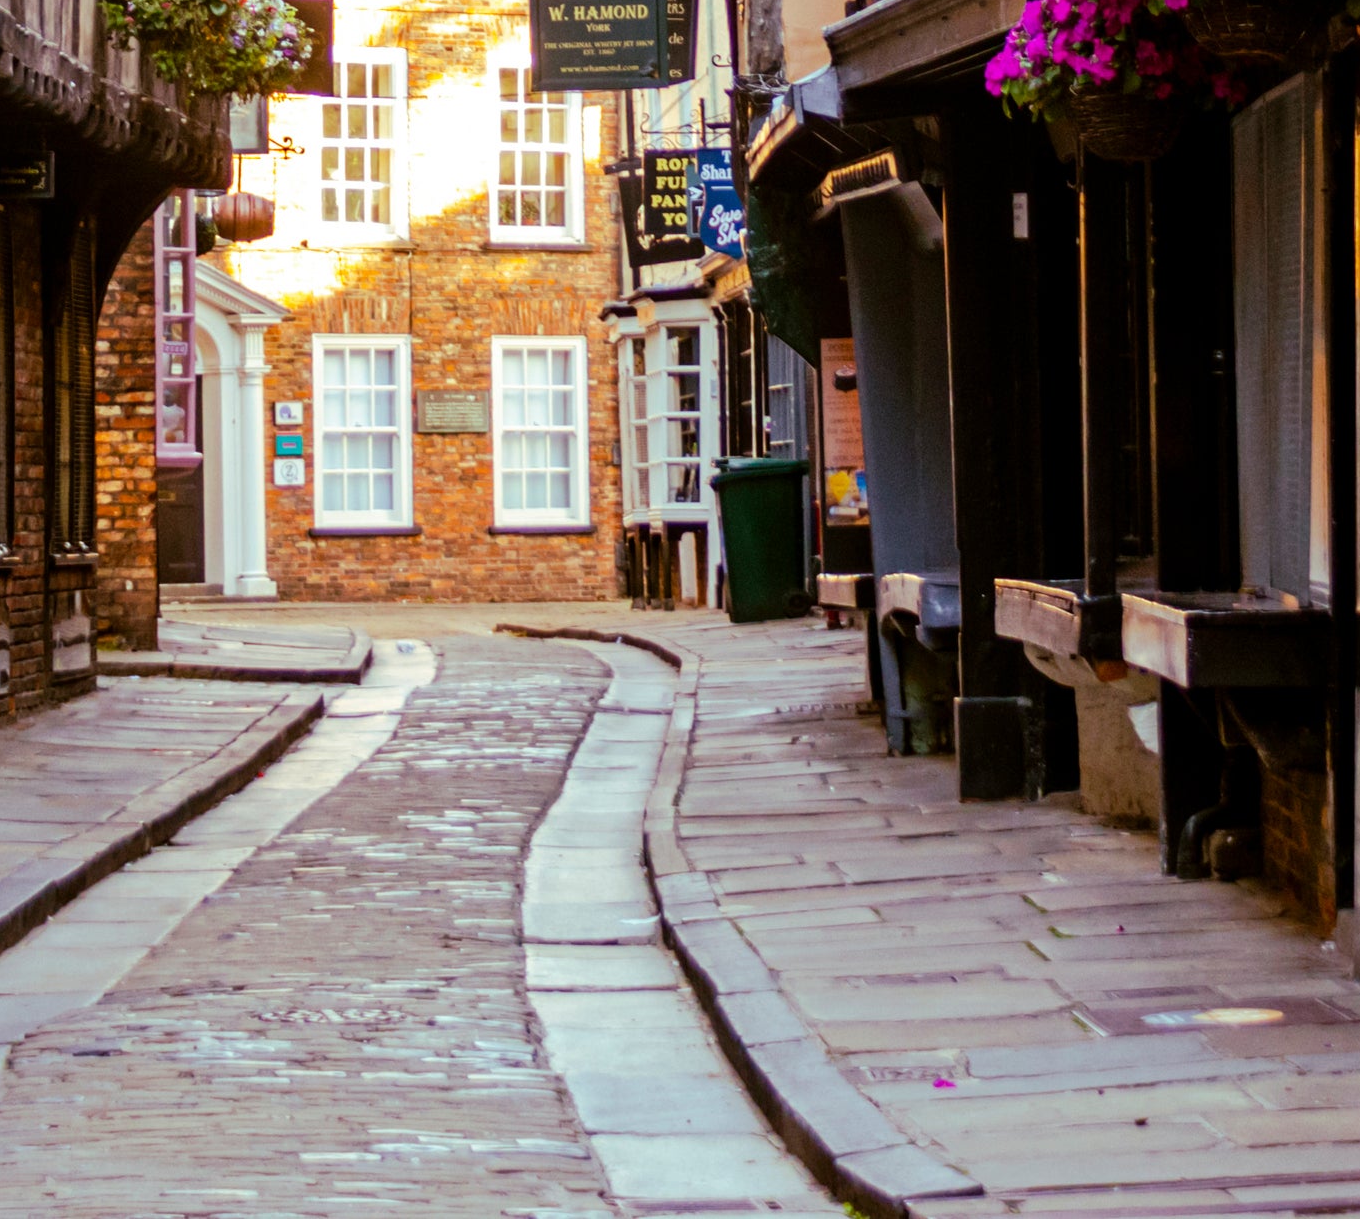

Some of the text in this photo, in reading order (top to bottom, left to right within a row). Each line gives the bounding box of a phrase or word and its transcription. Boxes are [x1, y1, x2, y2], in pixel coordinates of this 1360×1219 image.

[548, 4, 649, 21] W. HAMOND
[586, 23, 612, 32] YORK
[544, 39, 655, 49] THE ORIGINAL WHITBY JET SHOP
[560, 64, 640, 73] www.whamond.com
[662, 212, 688, 227] YO
